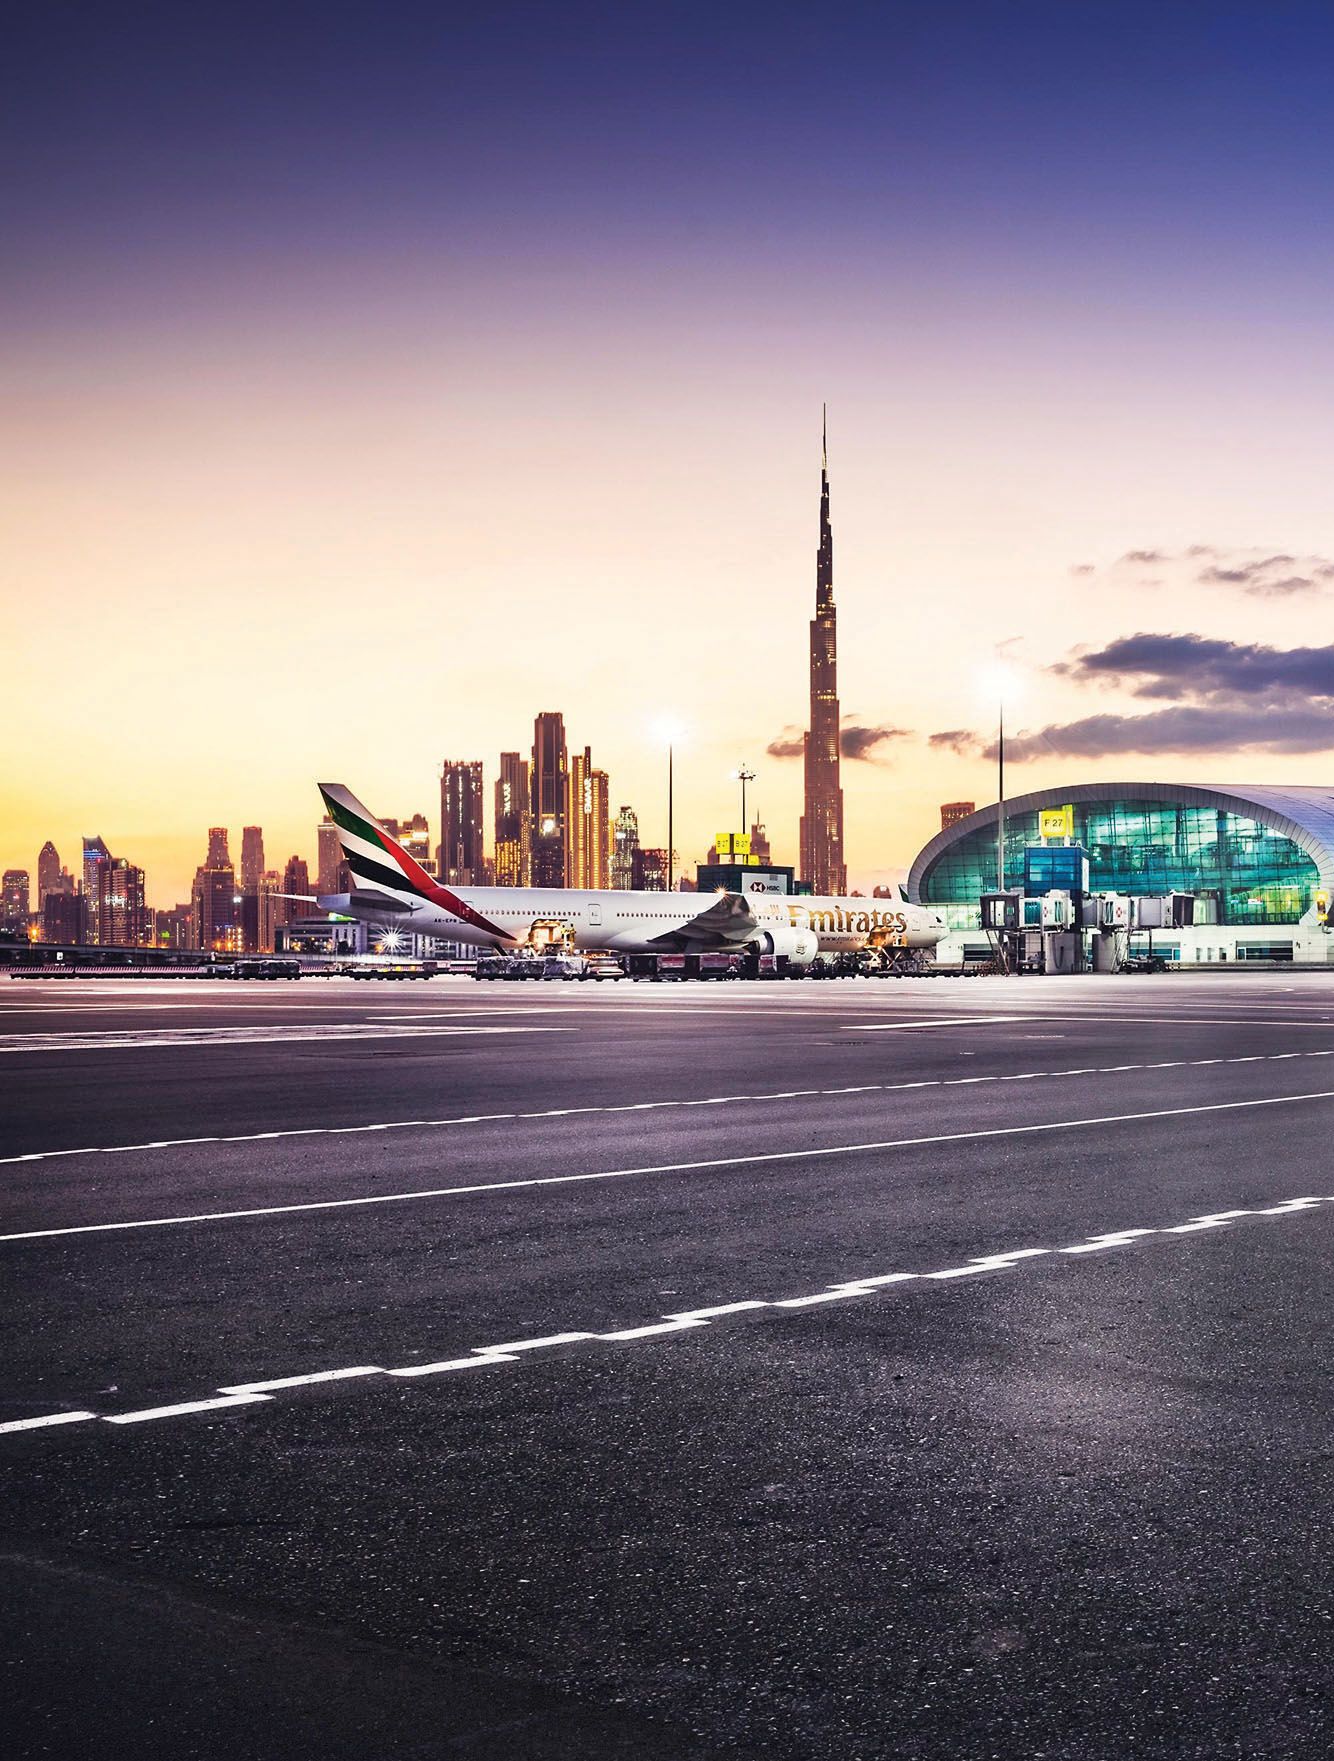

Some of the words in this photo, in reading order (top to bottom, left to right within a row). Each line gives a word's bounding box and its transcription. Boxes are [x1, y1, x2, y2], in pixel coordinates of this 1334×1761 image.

[1044, 818, 1050, 827] F
[1052, 818, 1063, 827] 27
[786, 904, 907, 933] Emirates
